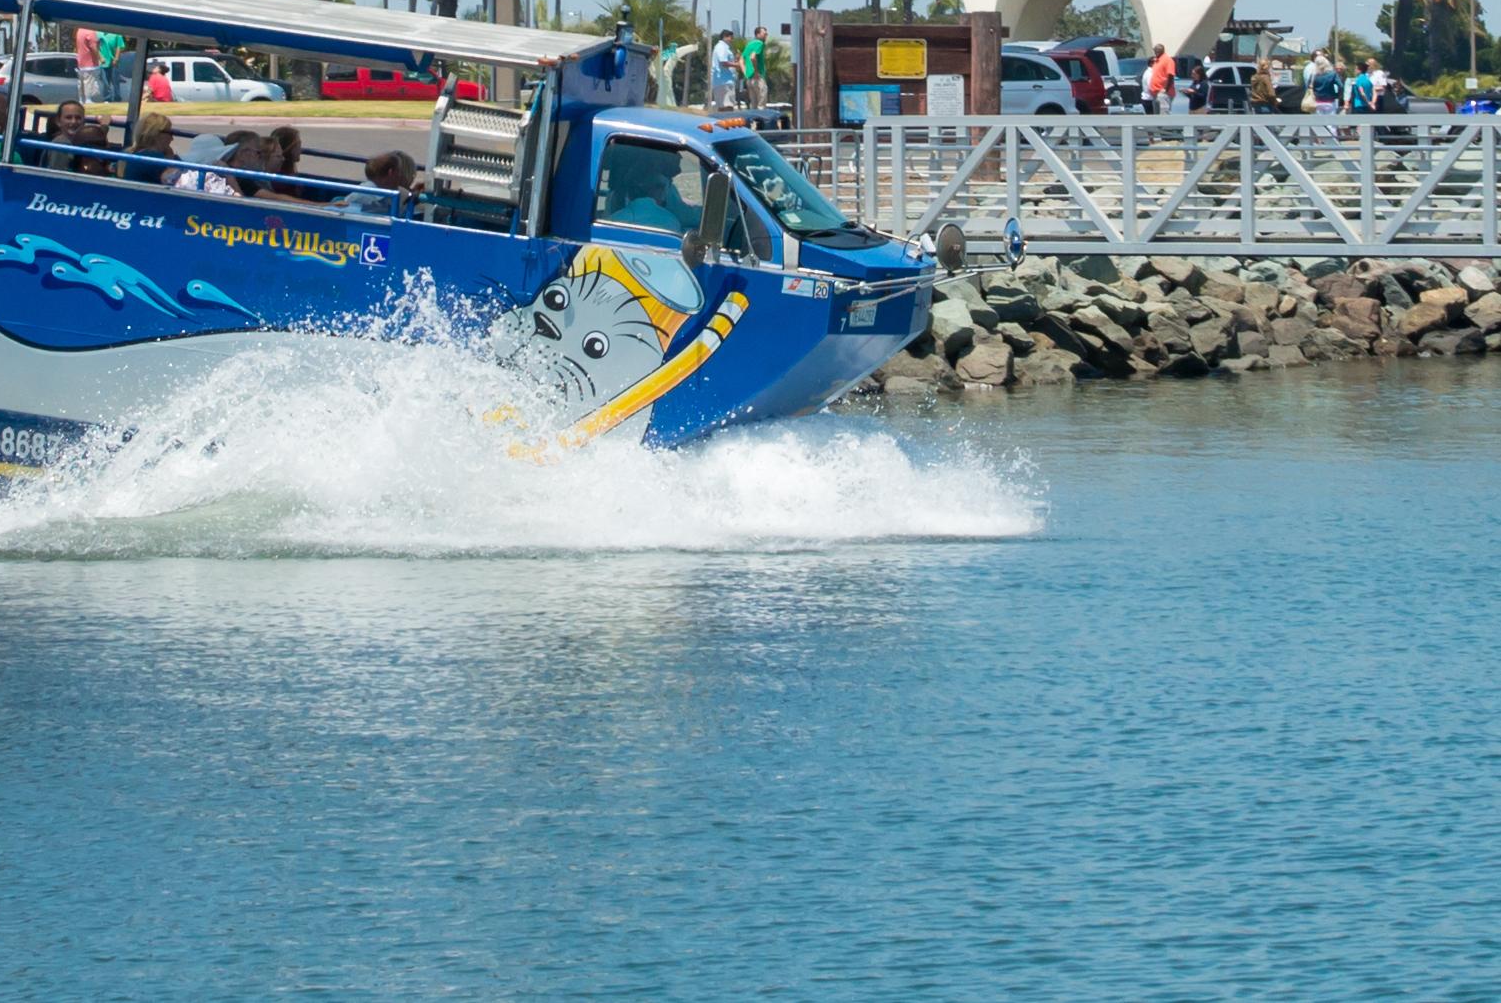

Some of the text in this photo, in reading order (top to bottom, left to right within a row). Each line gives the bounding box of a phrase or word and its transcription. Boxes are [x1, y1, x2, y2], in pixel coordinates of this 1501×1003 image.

[26, 193, 165, 229] Boarding at
[185, 215, 360, 265] Seaport Village
[816, 285, 828, 297] 20
